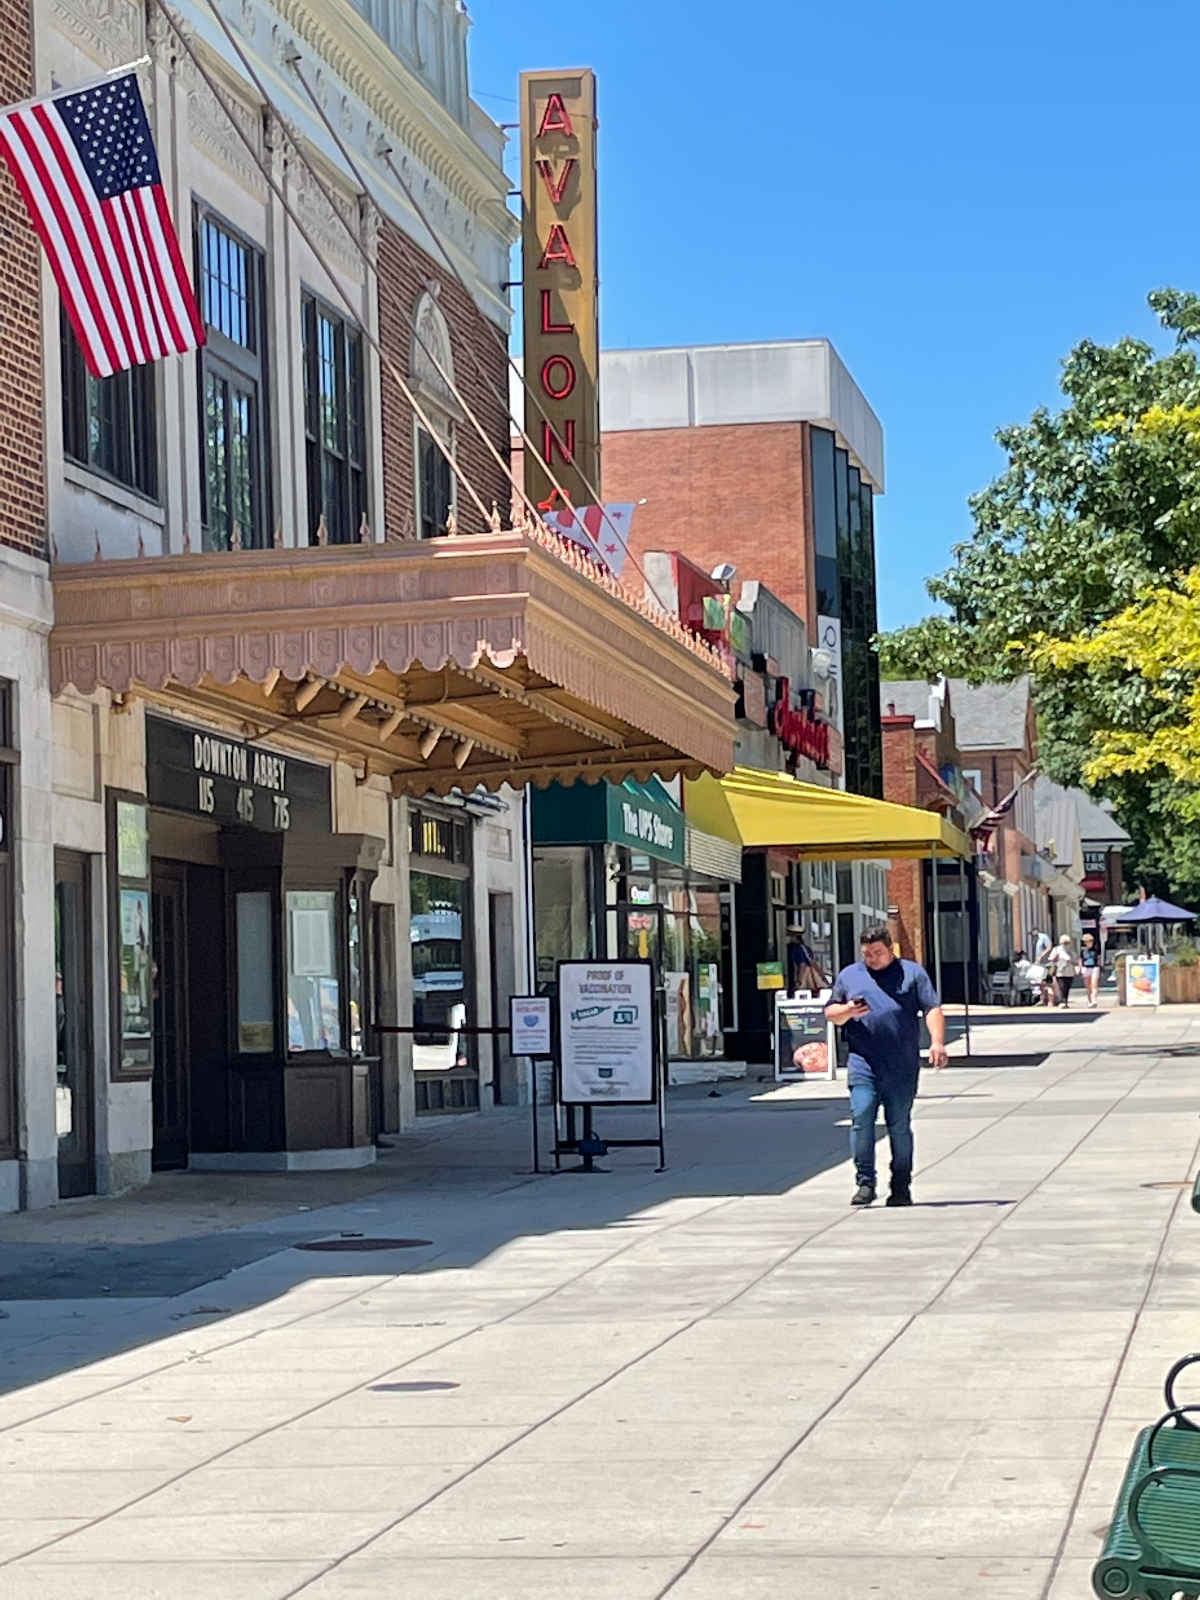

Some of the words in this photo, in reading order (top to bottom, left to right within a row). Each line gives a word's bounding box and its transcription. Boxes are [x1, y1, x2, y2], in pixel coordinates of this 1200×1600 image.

[535, 93, 576, 466] AVALON
[193, 734, 248, 782] DOWNTON
[253, 753, 286, 791] ABBEY
[622, 802, 638, 837] The
[638, 808, 653, 842] UPS
[653, 813, 674, 850] Store
[578, 983, 632, 994] VACCINATION
[586, 970, 612, 981] PROOF
[614, 970, 625, 981] OF
